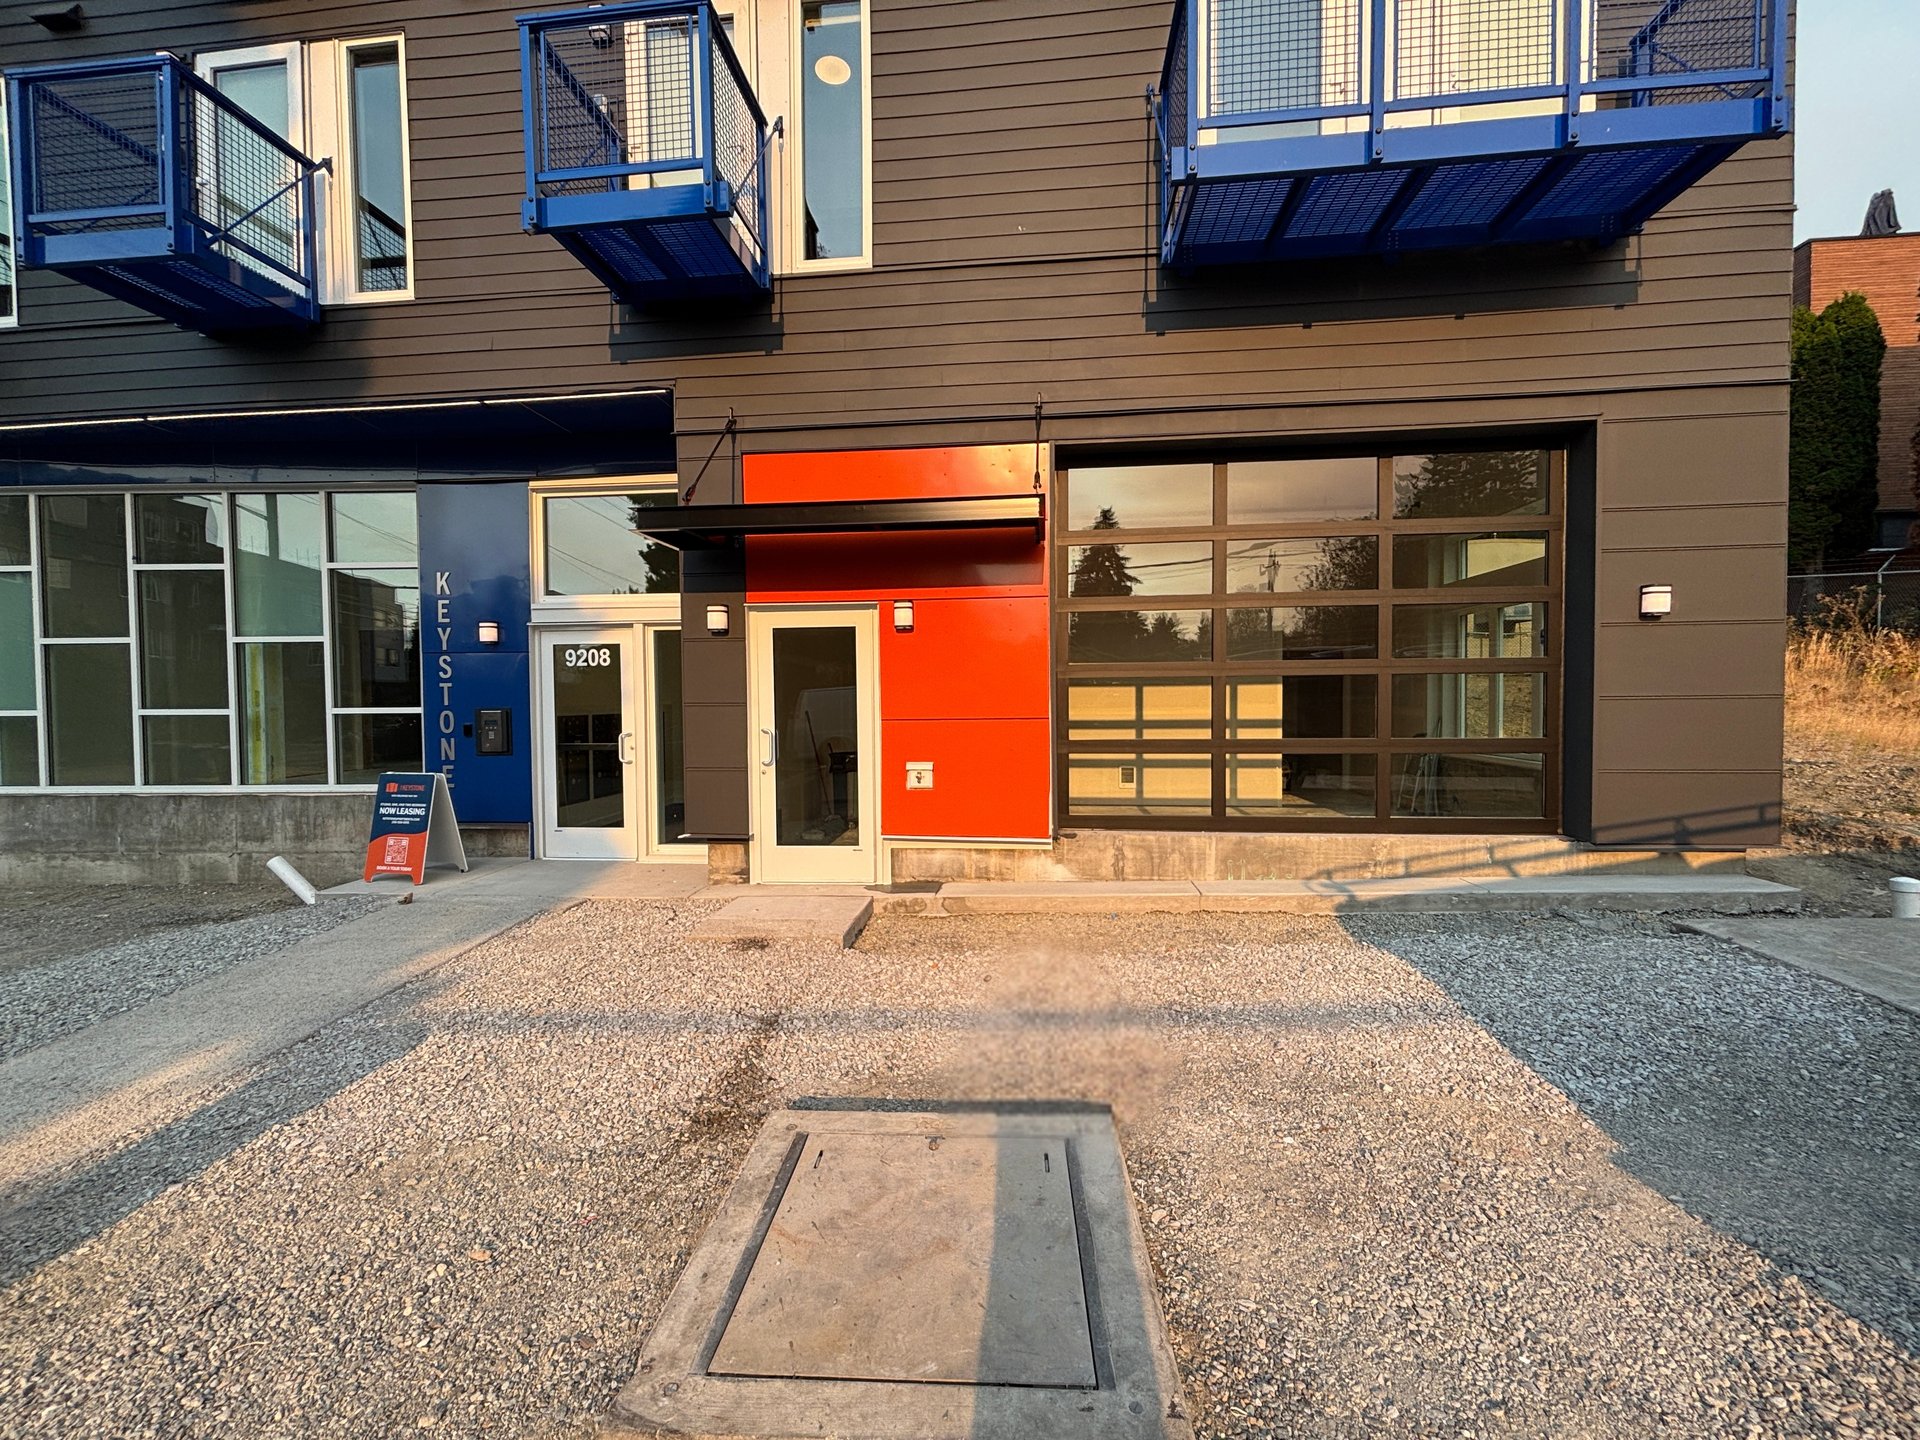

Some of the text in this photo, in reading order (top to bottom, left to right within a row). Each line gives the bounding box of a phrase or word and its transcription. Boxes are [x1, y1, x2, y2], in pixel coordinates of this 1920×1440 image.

[565, 648, 611, 667] 9208
[436, 571, 456, 788] KEYSTONE
[379, 807, 425, 815] NOW LEASING
